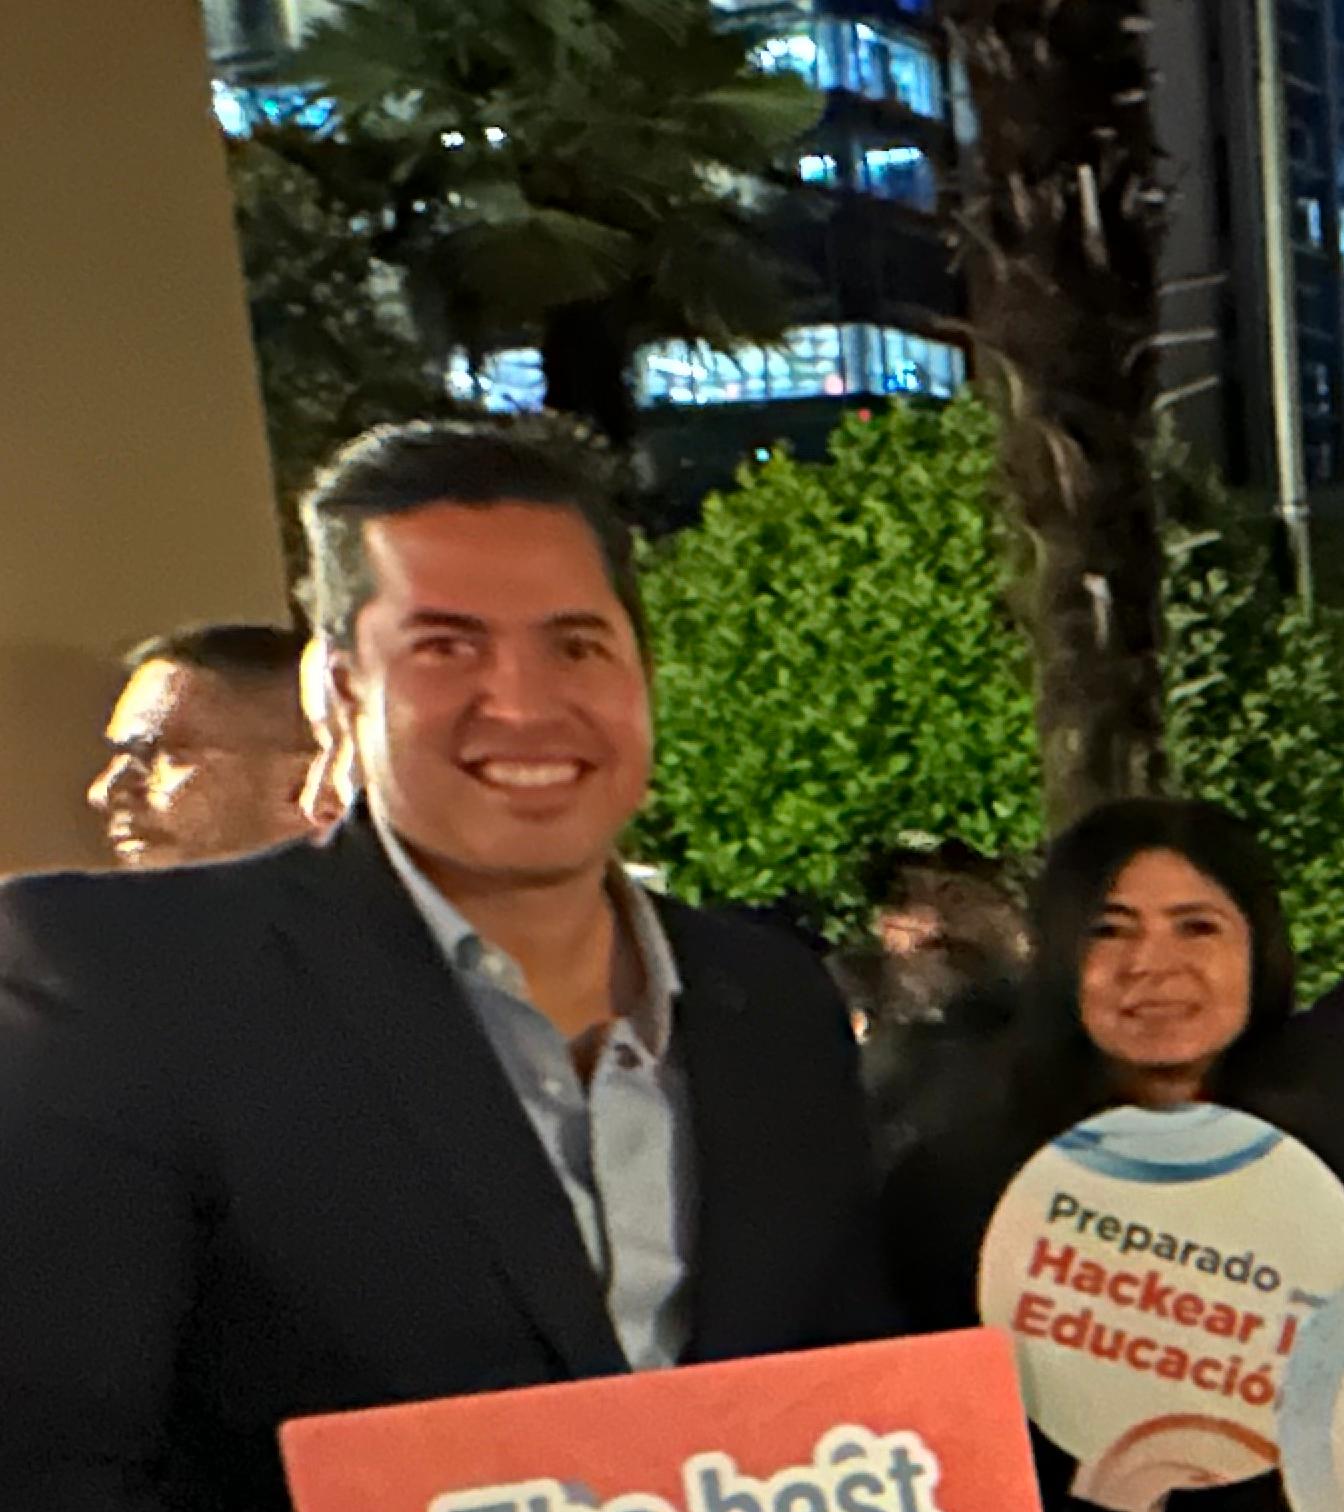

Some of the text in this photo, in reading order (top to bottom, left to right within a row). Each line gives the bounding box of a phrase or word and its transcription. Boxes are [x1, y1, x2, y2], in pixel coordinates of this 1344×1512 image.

[1027, 1237, 1264, 1344] Hackear
[1046, 1191, 1281, 1293] Preparado
[1013, 1291, 1284, 1411] Educació
